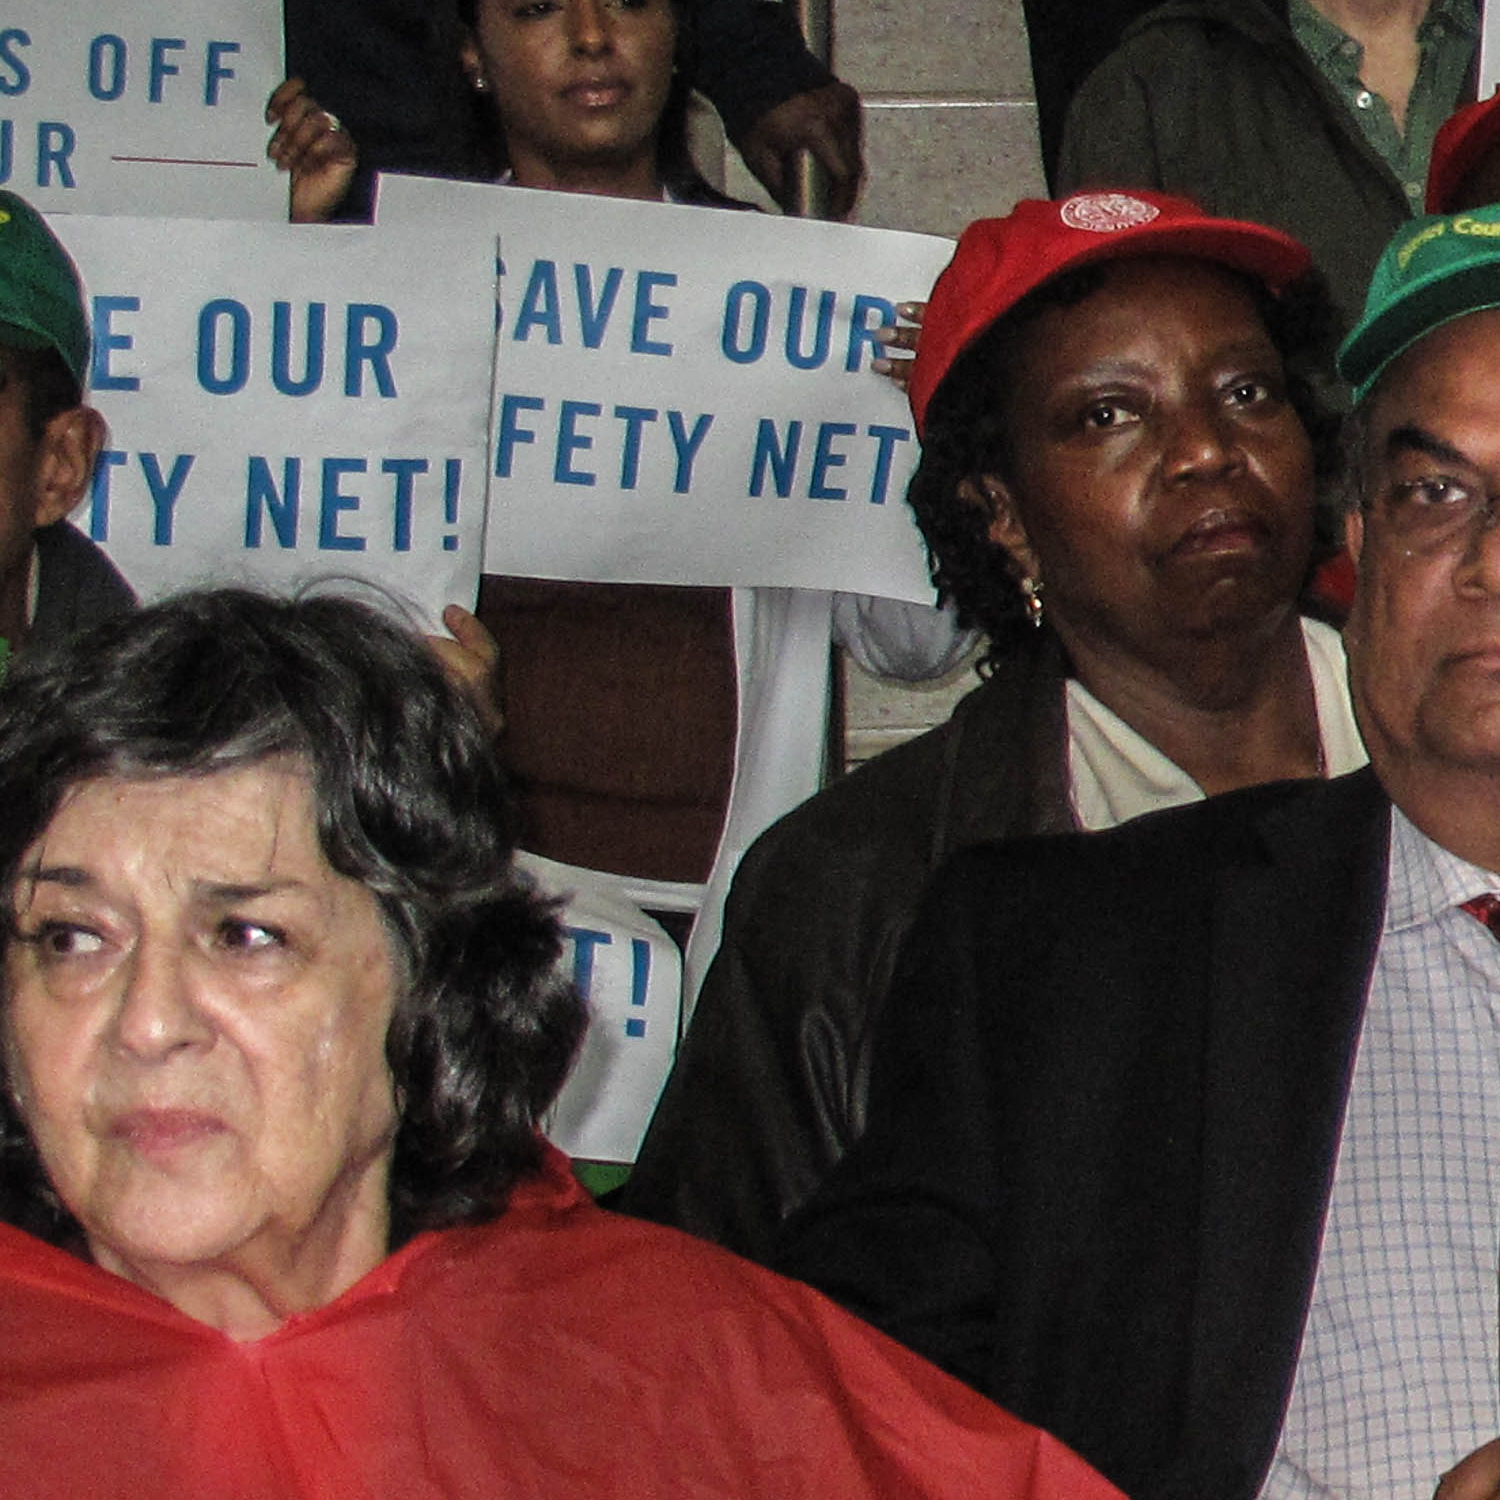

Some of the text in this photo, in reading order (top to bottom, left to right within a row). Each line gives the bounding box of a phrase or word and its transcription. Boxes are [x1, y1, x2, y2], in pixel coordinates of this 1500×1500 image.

[87, 32, 241, 107] OFF
[195, 299, 399, 399] OUR
[497, 258, 897, 372] AVE OUR
[495, 394, 912, 506] FETY NET
[244, 455, 463, 553] NET!
